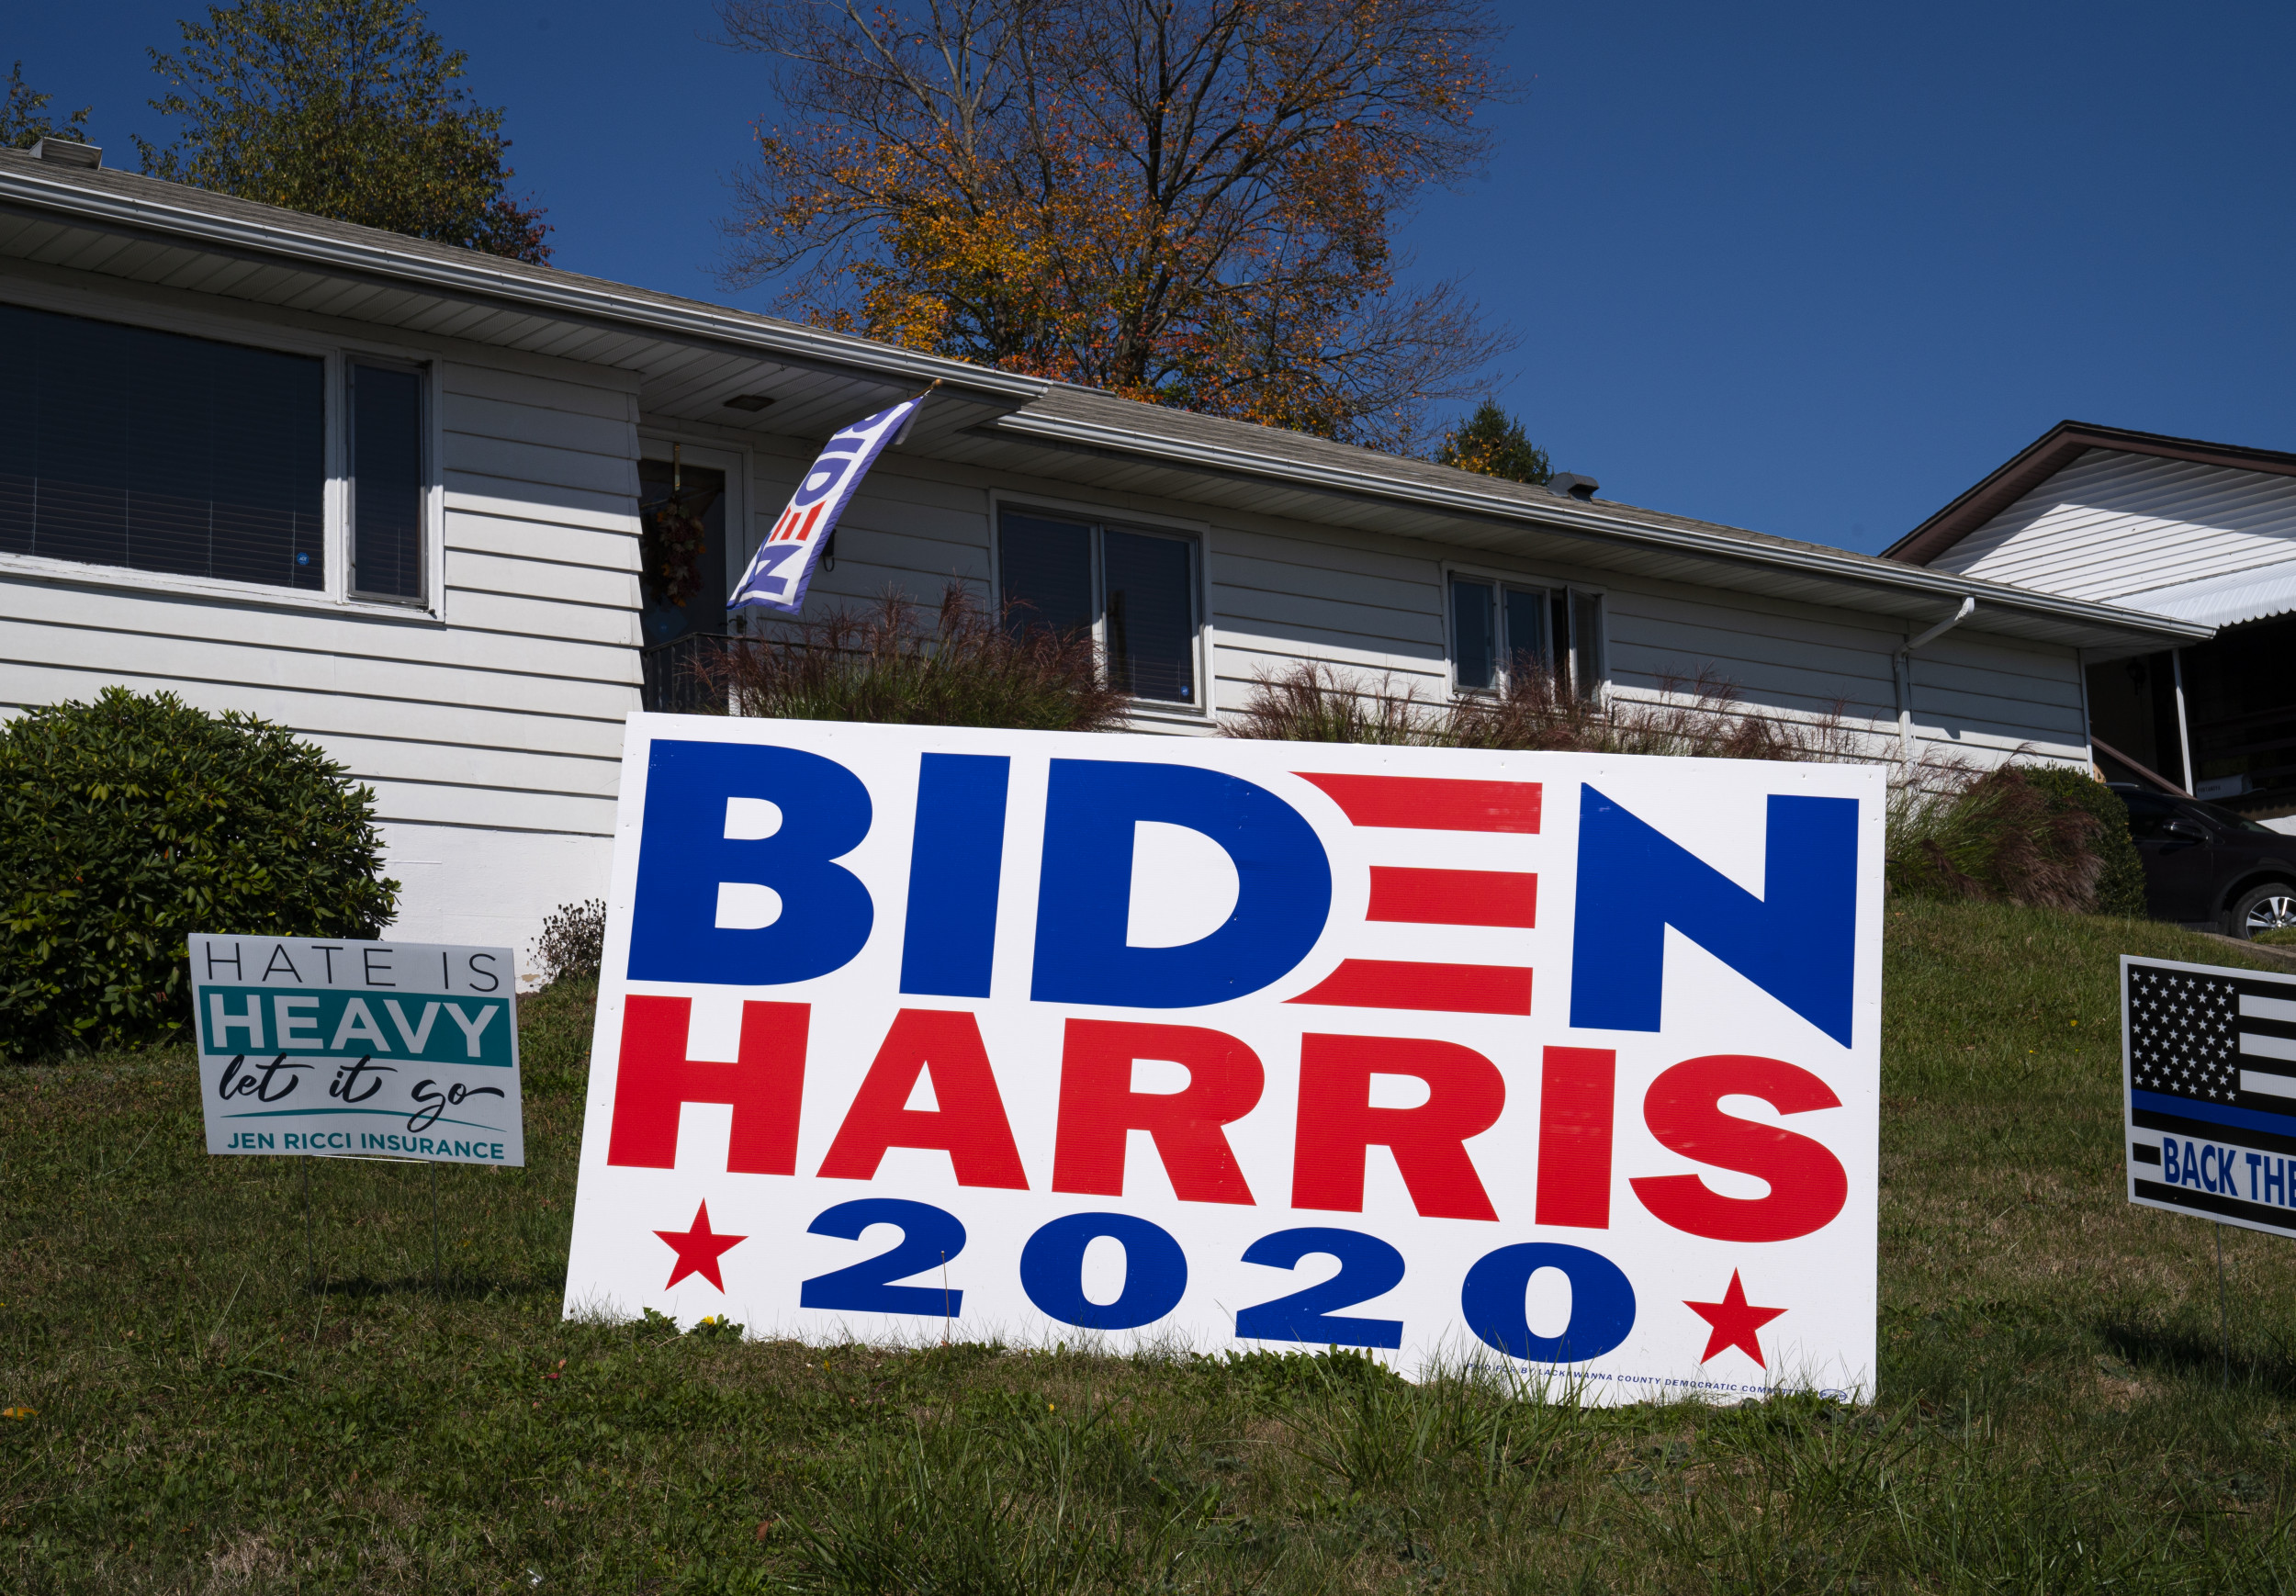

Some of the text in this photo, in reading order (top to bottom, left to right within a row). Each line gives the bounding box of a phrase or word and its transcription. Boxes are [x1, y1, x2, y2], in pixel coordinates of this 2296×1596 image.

[627, 739, 1860, 1050] BIDEN
[206, 941, 499, 993] HATE IS
[209, 993, 500, 1058] HEAVY
[219, 1052, 505, 1133] let it go
[607, 995, 1848, 1243] HARRIS
[228, 1132, 504, 1160] JEN RICCI INSURANCE
[2163, 1137, 2296, 1208] BACK THE
[800, 1198, 1637, 1364] 2020
[1617, 1375, 1661, 1385] COUNTY
[1664, 1378, 1737, 1391] DEMOCRATIC
